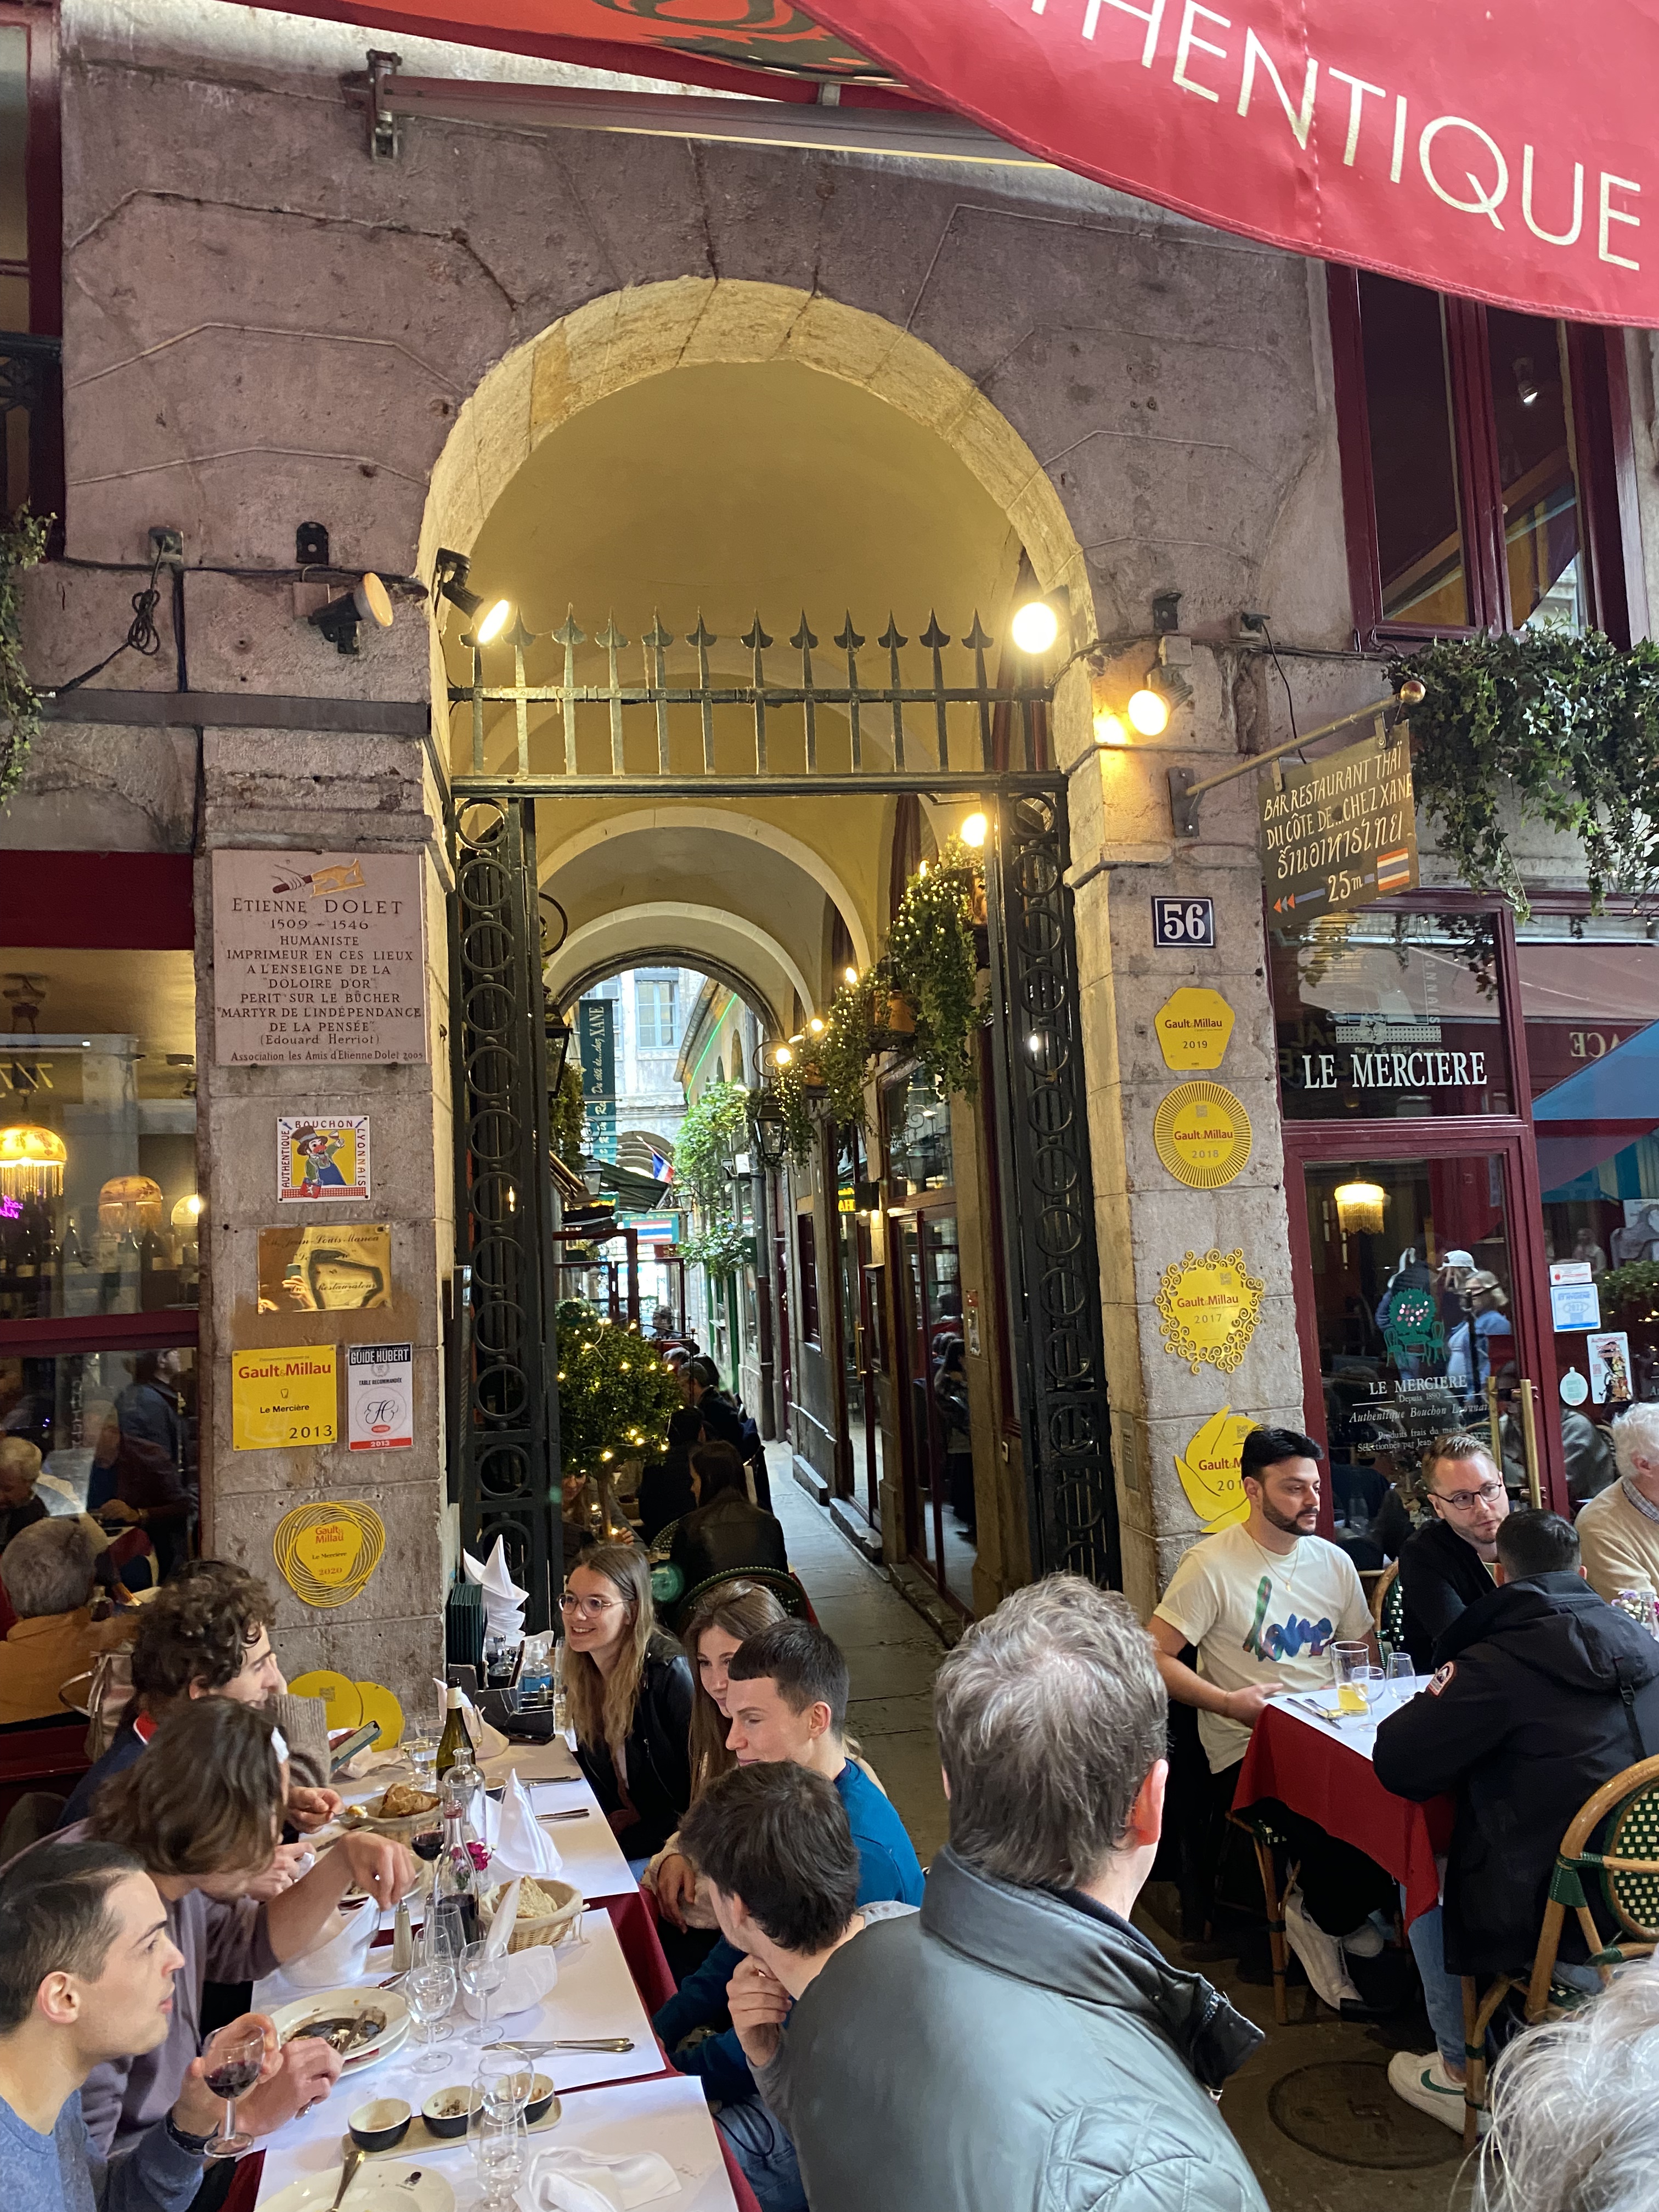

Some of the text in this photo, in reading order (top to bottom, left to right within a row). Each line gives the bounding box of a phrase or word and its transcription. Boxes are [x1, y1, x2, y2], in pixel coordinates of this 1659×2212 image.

[1031, 0, 1641, 271] HENTIQUE
[1263, 740, 1402, 821] BAR RESTAURANT THAÏ
[1267, 825, 1283, 850] DU
[1379, 772, 1412, 809] XANE
[232, 898, 403, 914] ETIENNE DOLET
[271, 919, 308, 929] 1509
[332, 921, 369, 930] 1546
[1163, 904, 1206, 940] 56
[280, 935, 359, 946] HUMANISTE
[227, 950, 414, 961] IMPRIMEUR EN CES LIEUX
[246, 964, 392, 974] A L'ENSEIGNE DE LA
[240, 990, 401, 1003] PERIT SUR LE BÛCHER
[281, 1008, 298, 1017] DE
[269, 1023, 287, 1032] DE
[294, 1023, 311, 1032] LA
[589, 1007, 605, 1036] XANE
[260, 1034, 380, 1046] (Edouard Herriot)
[1183, 1040, 1207, 1049] 2019
[231, 1049, 284, 1062] Association
[288, 1051, 302, 1060] les
[304, 1050, 328, 1060] Amis
[374, 1049, 399, 1059] Dolet
[403, 1052, 424, 1061] 2005
[1302, 1054, 1338, 1089] LE
[1350, 1051, 1488, 1088] MERCIERE
[295, 1120, 353, 1128] BOUCHON
[281, 1130, 290, 1188] AUTHENTIQUE
[357, 1128, 366, 1186] LYONNAIS
[1192, 1149, 1219, 1159] 2018
[1194, 1313, 1222, 1324] 2017
[351, 1348, 409, 1364] GUIDE HUBERT
[1369, 1375, 1468, 1395] LE MERCIERE
[1399, 1395, 1423, 1403] Depuis
[273, 1403, 310, 1413] Mercière
[1348, 1410, 1406, 1423] Authentique
[1410, 1405, 1447, 1418] Bouchon
[289, 1425, 332, 1439] 2013
[1378, 1430, 1408, 1440] Produits
[1411, 1428, 1426, 1437] frais
[1430, 1426, 1438, 1435] du
[1403, 1442, 1414, 1450] par
[1217, 1480, 1242, 1491] 201
[315, 1533, 344, 1544] Millau
[318, 1567, 343, 1576] 2020
